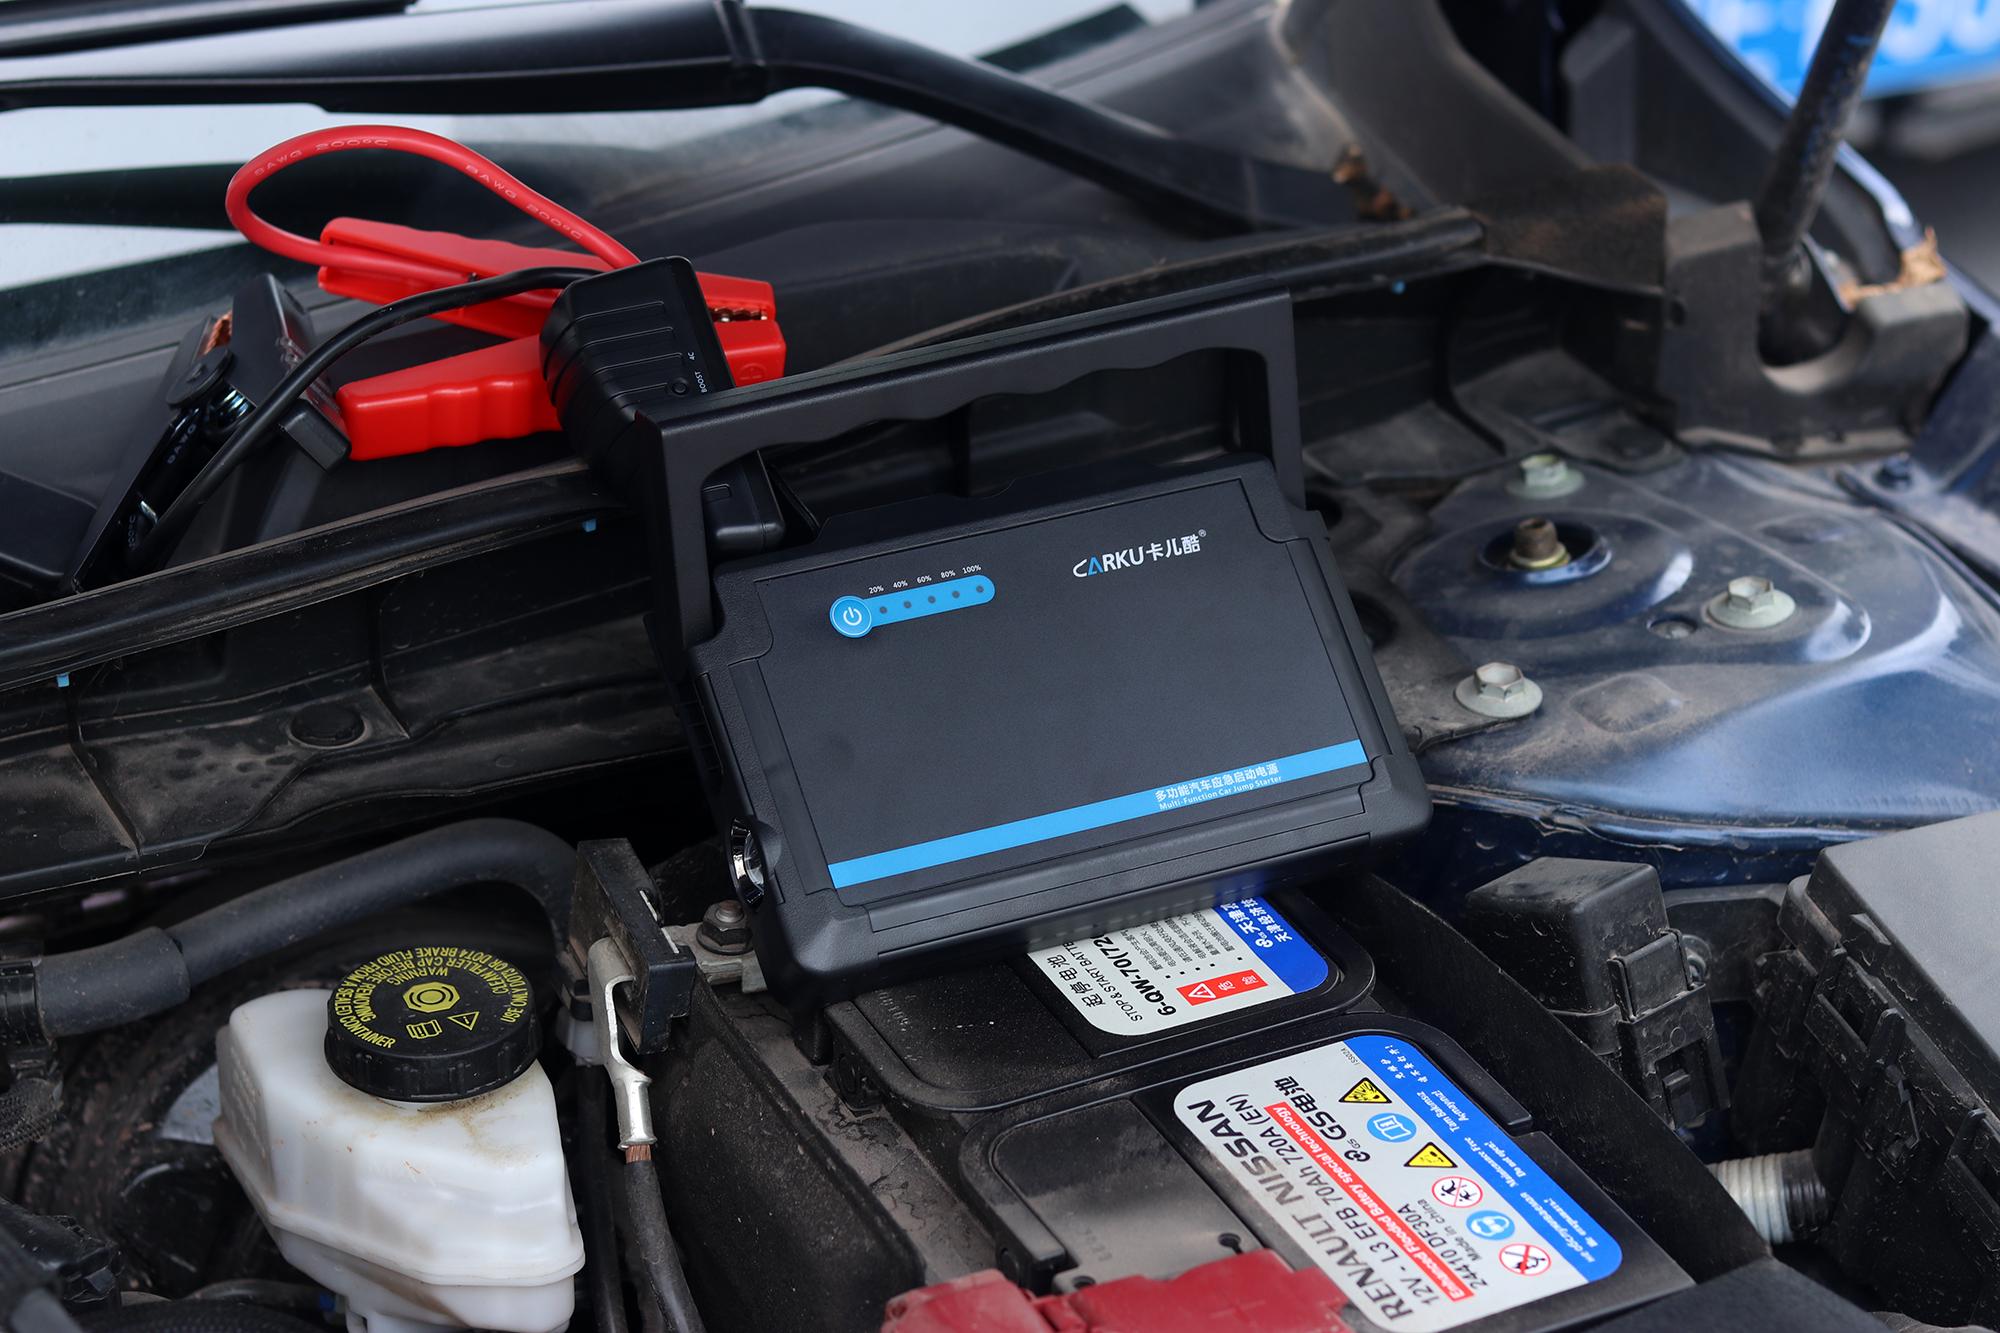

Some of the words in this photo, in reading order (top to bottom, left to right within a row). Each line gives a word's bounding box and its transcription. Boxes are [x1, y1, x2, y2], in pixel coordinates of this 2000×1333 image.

[694, 371, 708, 393] BOOST
[1072, 546, 1144, 578] CARKU
[868, 585, 885, 594] 20%
[892, 580, 908, 589] 40%
[916, 575, 932, 584] 60%
[940, 570, 956, 579] 80%
[962, 564, 982, 574] 100%
[1154, 762, 1280, 802] 多功能汽车应急启动电源
[1159, 791, 1217, 811] Multi-Function
[1218, 786, 1233, 799] Car
[1233, 782, 1255, 794] Jump
[1255, 775, 1282, 787] Starter
[377, 950, 414, 966] FLUID
[415, 947, 458, 957] BRAKE
[417, 957, 444, 967] CAP
[459, 949, 493, 964] DOT4
[488, 958, 509, 971] OR
[347, 961, 381, 983] FROM
[367, 960, 416, 984] BEFORE
[386, 966, 449, 986] WARNING
[446, 957, 490, 975] FILLER
[501, 967, 526, 988] DOT3
[341, 980, 358, 988] A
[480, 970, 509, 994] CLEAN
[1047, 954, 1105, 1007] 起停电池
[1084, 967, 1116, 992] START
[334, 987, 354, 1016] SEALED
[353, 982, 377, 1023] REMOVING
[510, 988, 528, 1007] ONLY
[1114, 999, 1143, 1021] STOP
[500, 1007, 524, 1023] USE
[339, 1015, 396, 1048] CONTAINER
[1225, 1093, 1270, 1125] (EN)
[1273, 1106, 1322, 1153] technology
[1442, 1115, 1459, 1132] Tam
[1187, 1100, 1301, 1203] NISSAN
[1259, 1125, 1303, 1165] 720A
[1464, 1136, 1481, 1152] Free
[1483, 1140, 1506, 1157] open!
[1315, 1152, 1352, 1183] special
[1478, 1150, 1516, 1187] Maintenance
[1502, 1156, 1516, 1167] not
[1513, 1166, 1526, 1177] Do
[1299, 1165, 1342, 1205] 70Ah
[1348, 1183, 1384, 1216] Battery
[1416, 1198, 1445, 1224] china
[1335, 1206, 1377, 1240] EFB
[1377, 1215, 1420, 1253] Flooded
[1397, 1203, 1446, 1248] DF30A
[1443, 1225, 1457, 1235] in
[1368, 1241, 1399, 1262] L3
[1454, 1236, 1480, 1261] Made
[1292, 1214, 1412, 1319] RENAULT
[1413, 1251, 1464, 1298] Enhanced
[1439, 1248, 1487, 1288] 24410
[1400, 1277, 1438, 1304] 12V
